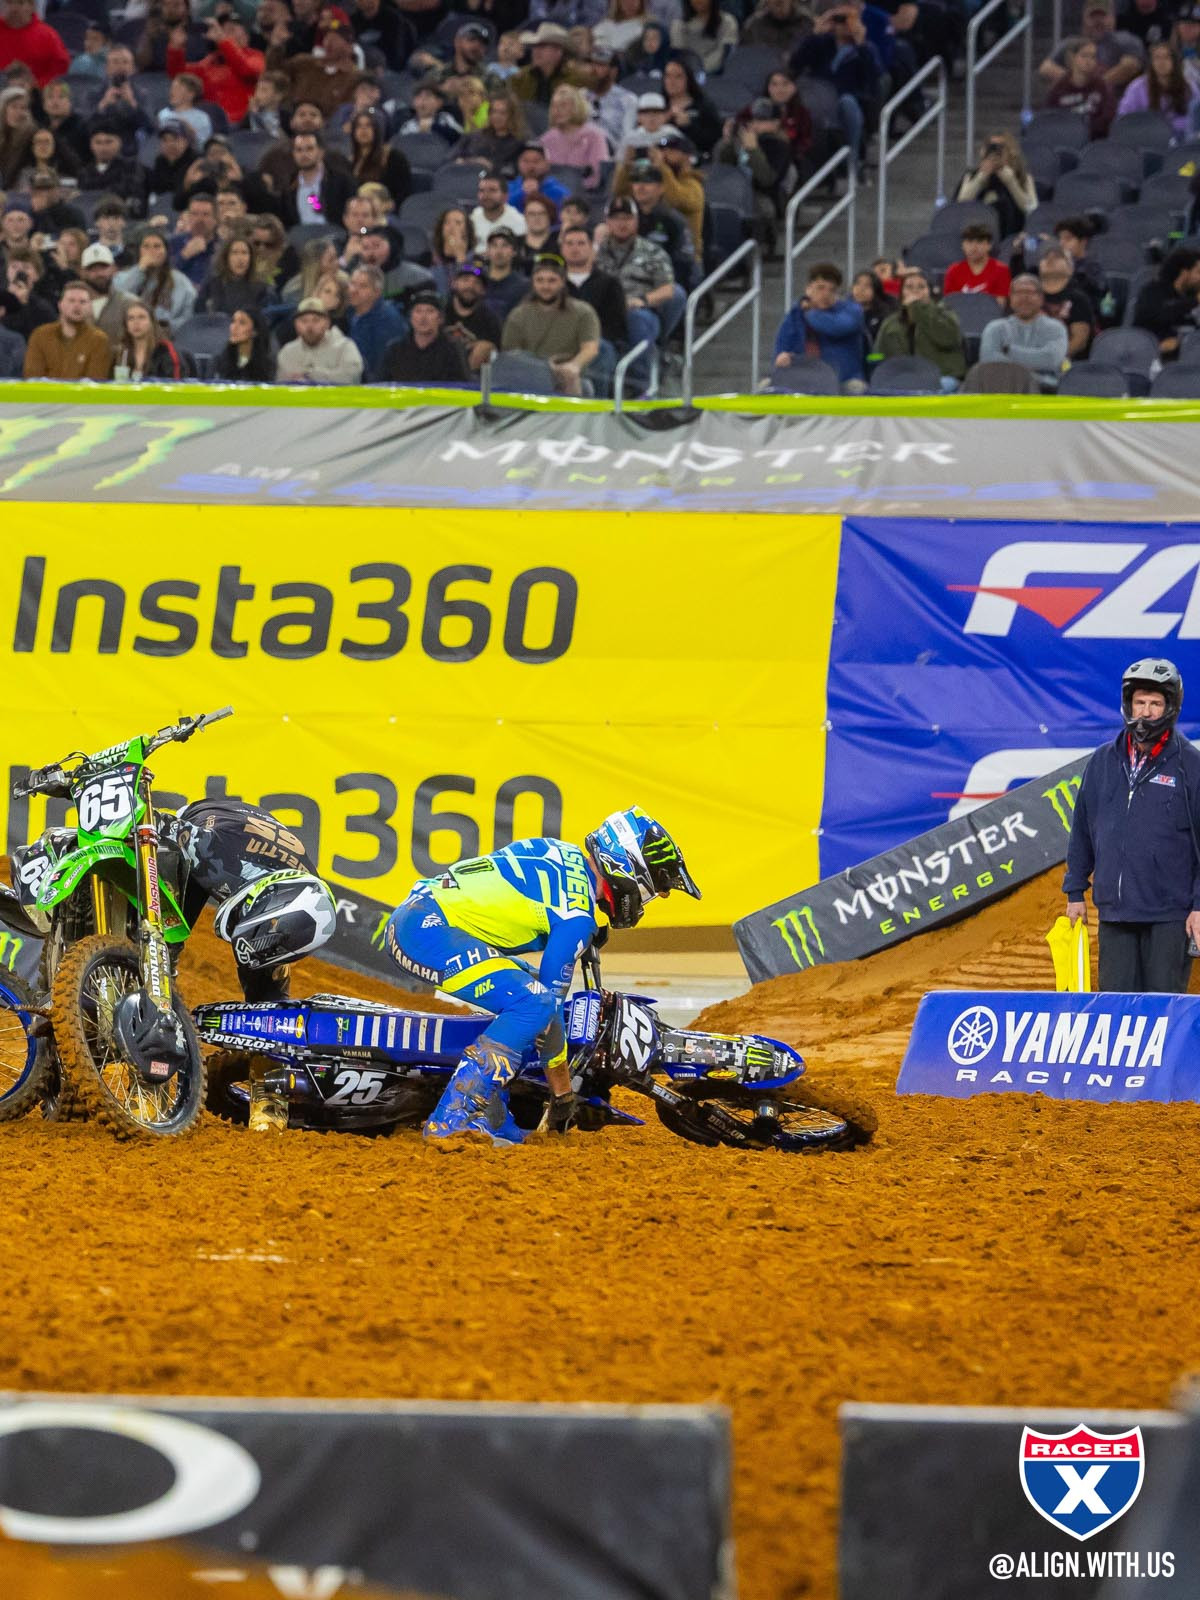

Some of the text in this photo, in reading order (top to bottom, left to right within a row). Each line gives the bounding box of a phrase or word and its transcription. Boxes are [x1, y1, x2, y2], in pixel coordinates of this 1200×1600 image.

[440, 434, 958, 466] MONSTER
[12, 556, 579, 664] Insta360
[79, 774, 135, 832] 65
[243, 816, 306, 856] 65
[831, 811, 1039, 925] MONSTER
[879, 858, 1017, 936] ENERGY
[391, 939, 440, 984] YAMAHA
[571, 999, 586, 1038] PROTAPER
[620, 999, 653, 1072] 25
[1001, 1010, 1170, 1068] YAMAHA
[213, 1031, 276, 1051] DUNLOP
[342, 1048, 372, 1059] YAMAHA
[323, 1070, 388, 1105] 25
[956, 1068, 1147, 1089] RACING
